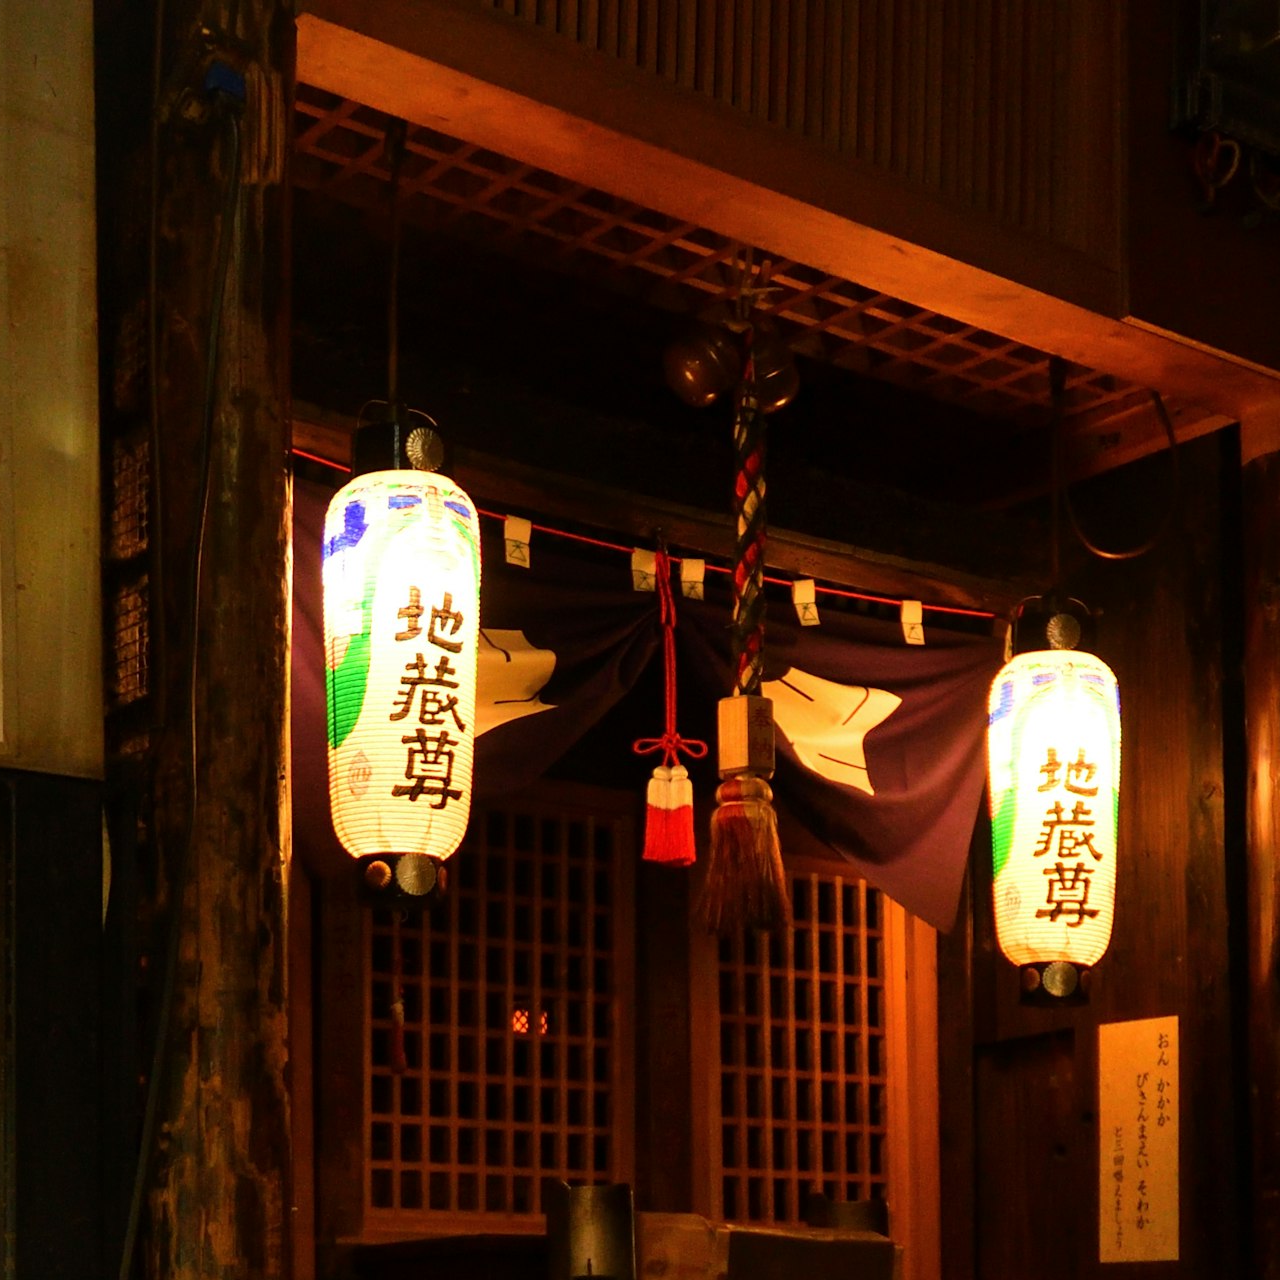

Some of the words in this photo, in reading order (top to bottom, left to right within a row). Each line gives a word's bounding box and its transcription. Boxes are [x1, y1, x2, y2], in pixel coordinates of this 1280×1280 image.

[389, 585, 466, 810] 地蔵尊
[1033, 747, 1103, 928] 地蔵尊
[1156, 1032, 1170, 1067] おん
[1156, 1078, 1171, 1128] かかか
[1136, 1180, 1150, 1230] そわか
